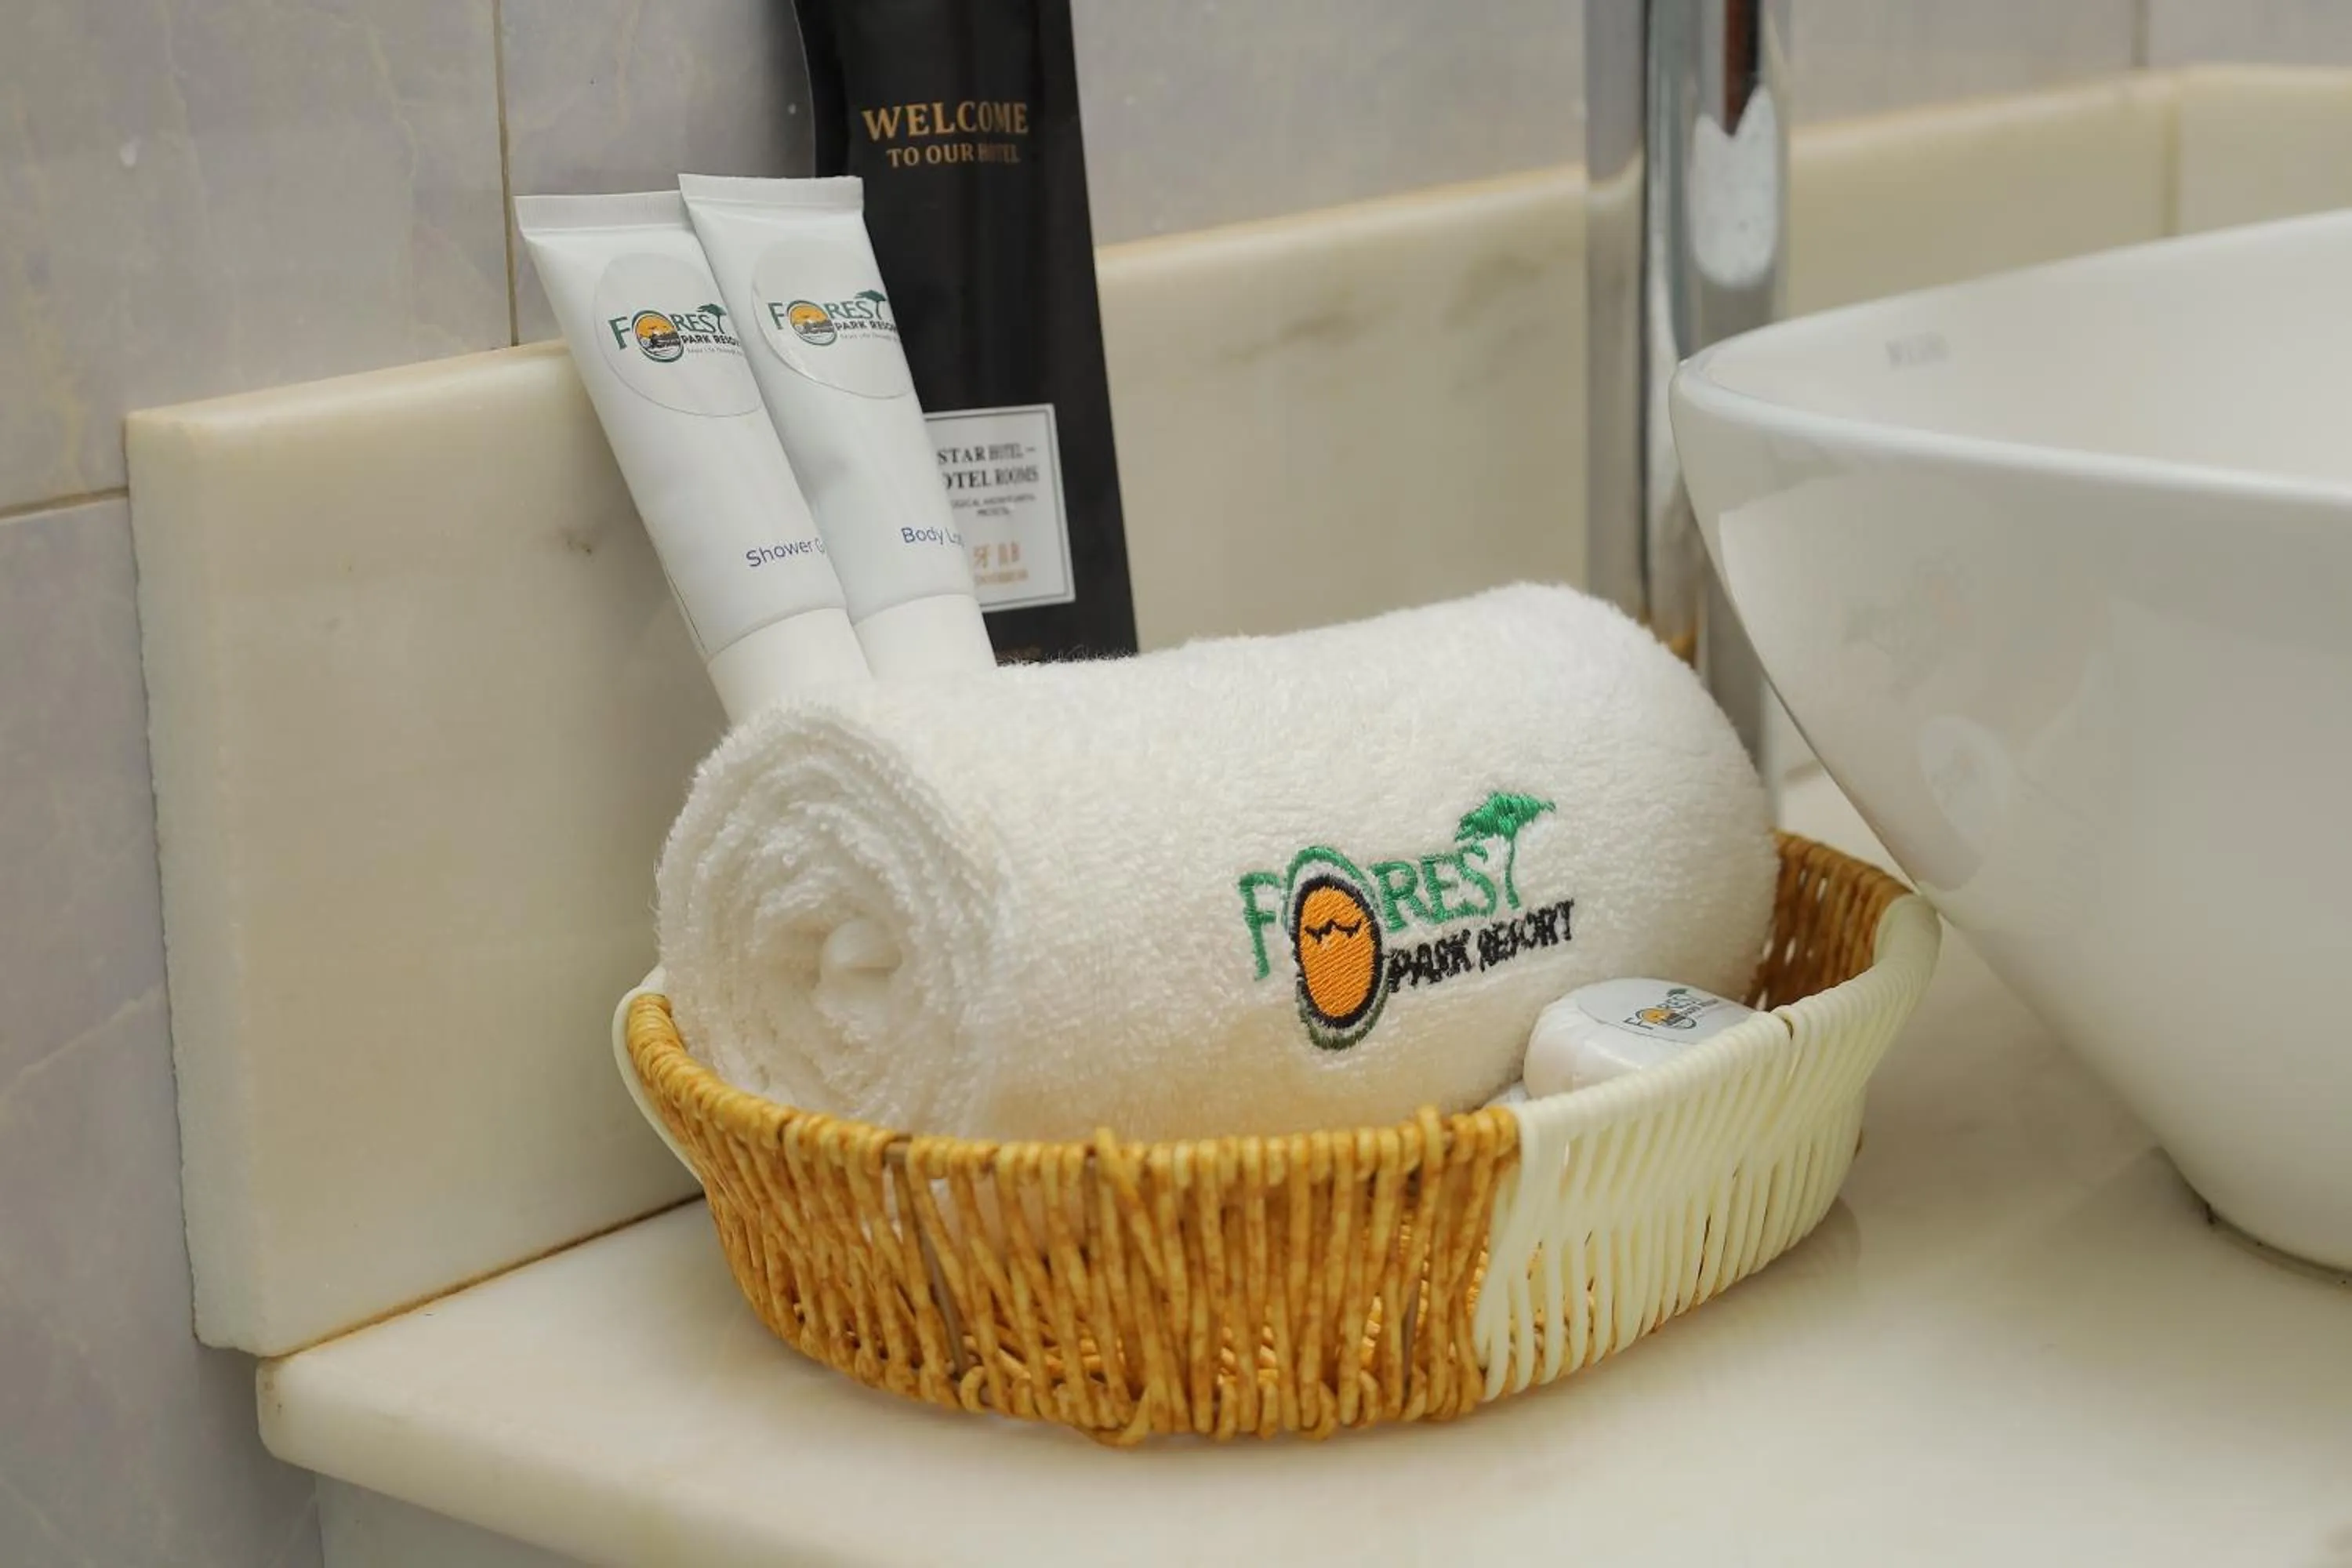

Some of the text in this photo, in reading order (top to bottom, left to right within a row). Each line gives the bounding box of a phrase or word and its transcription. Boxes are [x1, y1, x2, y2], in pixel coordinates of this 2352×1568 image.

[862, 100, 1029, 142] WELCOME
[887, 147, 920, 168] TO
[926, 142, 974, 165] OUR
[768, 289, 887, 346] FOREST
[834, 321, 897, 332] PARK RESO
[608, 303, 727, 362] FOREST
[681, 335, 741, 346] PARK RESO
[937, 446, 985, 465] STAR
[901, 527, 943, 546] Body
[746, 541, 813, 568] Shower
[1238, 791, 1557, 1051] FOREST
[1385, 898, 1575, 993] PARK RESORT
